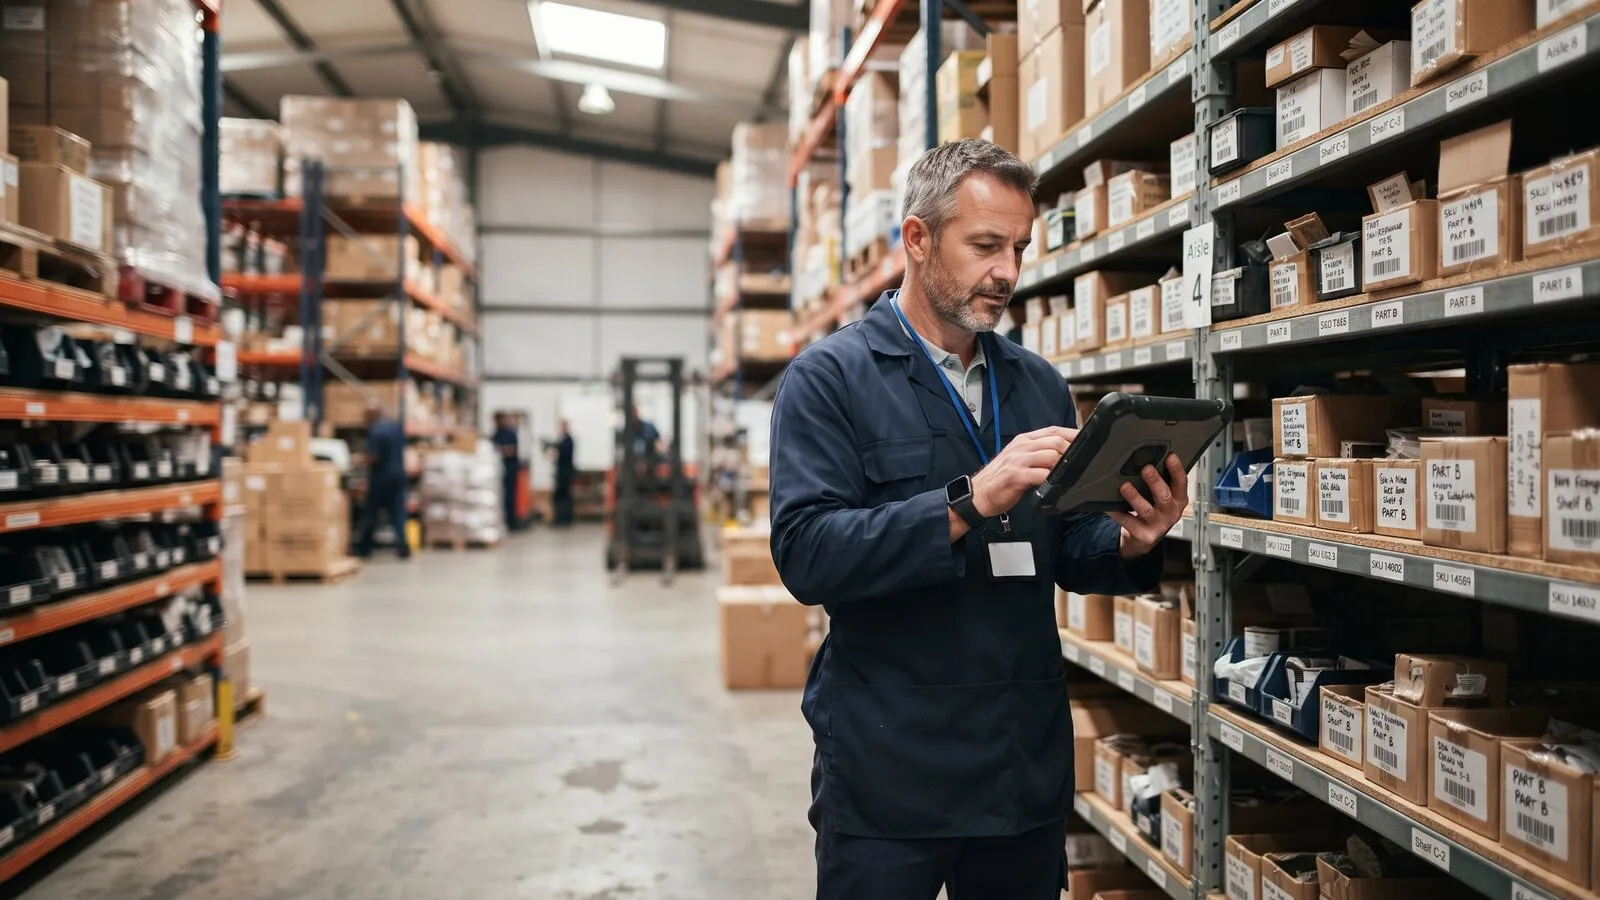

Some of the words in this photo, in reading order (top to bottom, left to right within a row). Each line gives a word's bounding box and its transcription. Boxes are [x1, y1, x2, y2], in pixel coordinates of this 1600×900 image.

[1545, 40, 1569, 60] Aisle
[1571, 36, 1579, 49] 8
[1449, 84, 1469, 103] Shelf
[1530, 186, 1549, 200] SKU
[1444, 207, 1457, 218] SKU
[1535, 201, 1551, 216] SKU
[1447, 218, 1464, 231] PART
[1449, 229, 1467, 242] PART
[1469, 228, 1475, 237] B
[1187, 239, 1209, 261] Aisle
[1371, 248, 1386, 260] PART
[1387, 246, 1393, 256] B
[1192, 273, 1203, 307] 4
[1540, 278, 1563, 292] PART
[1566, 277, 1573, 289] B
[1450, 296, 1469, 308] PART
[1471, 295, 1476, 305] B
[1375, 309, 1391, 320] PART
[1392, 308, 1398, 318] B
[1269, 328, 1282, 337] PART
[1283, 326, 1288, 335] B
[1432, 463, 1451, 478] PART
[1454, 463, 1461, 480] B
[1556, 495, 1580, 511] Shelf
[1381, 507, 1399, 519] PART
[1266, 540, 1277, 550] SKU
[1309, 549, 1320, 558] SKU
[1371, 560, 1384, 571] SKU
[1436, 571, 1449, 583] SKU
[1552, 591, 1569, 605] SKU
[1512, 769, 1534, 788] PART
[1538, 779, 1546, 795] B
[1344, 796, 1355, 810] C-2
[1514, 789, 1537, 809] PART
[1541, 800, 1549, 817] B
[1414, 836, 1432, 853] Shelf
[1433, 846, 1446, 862] C-2
